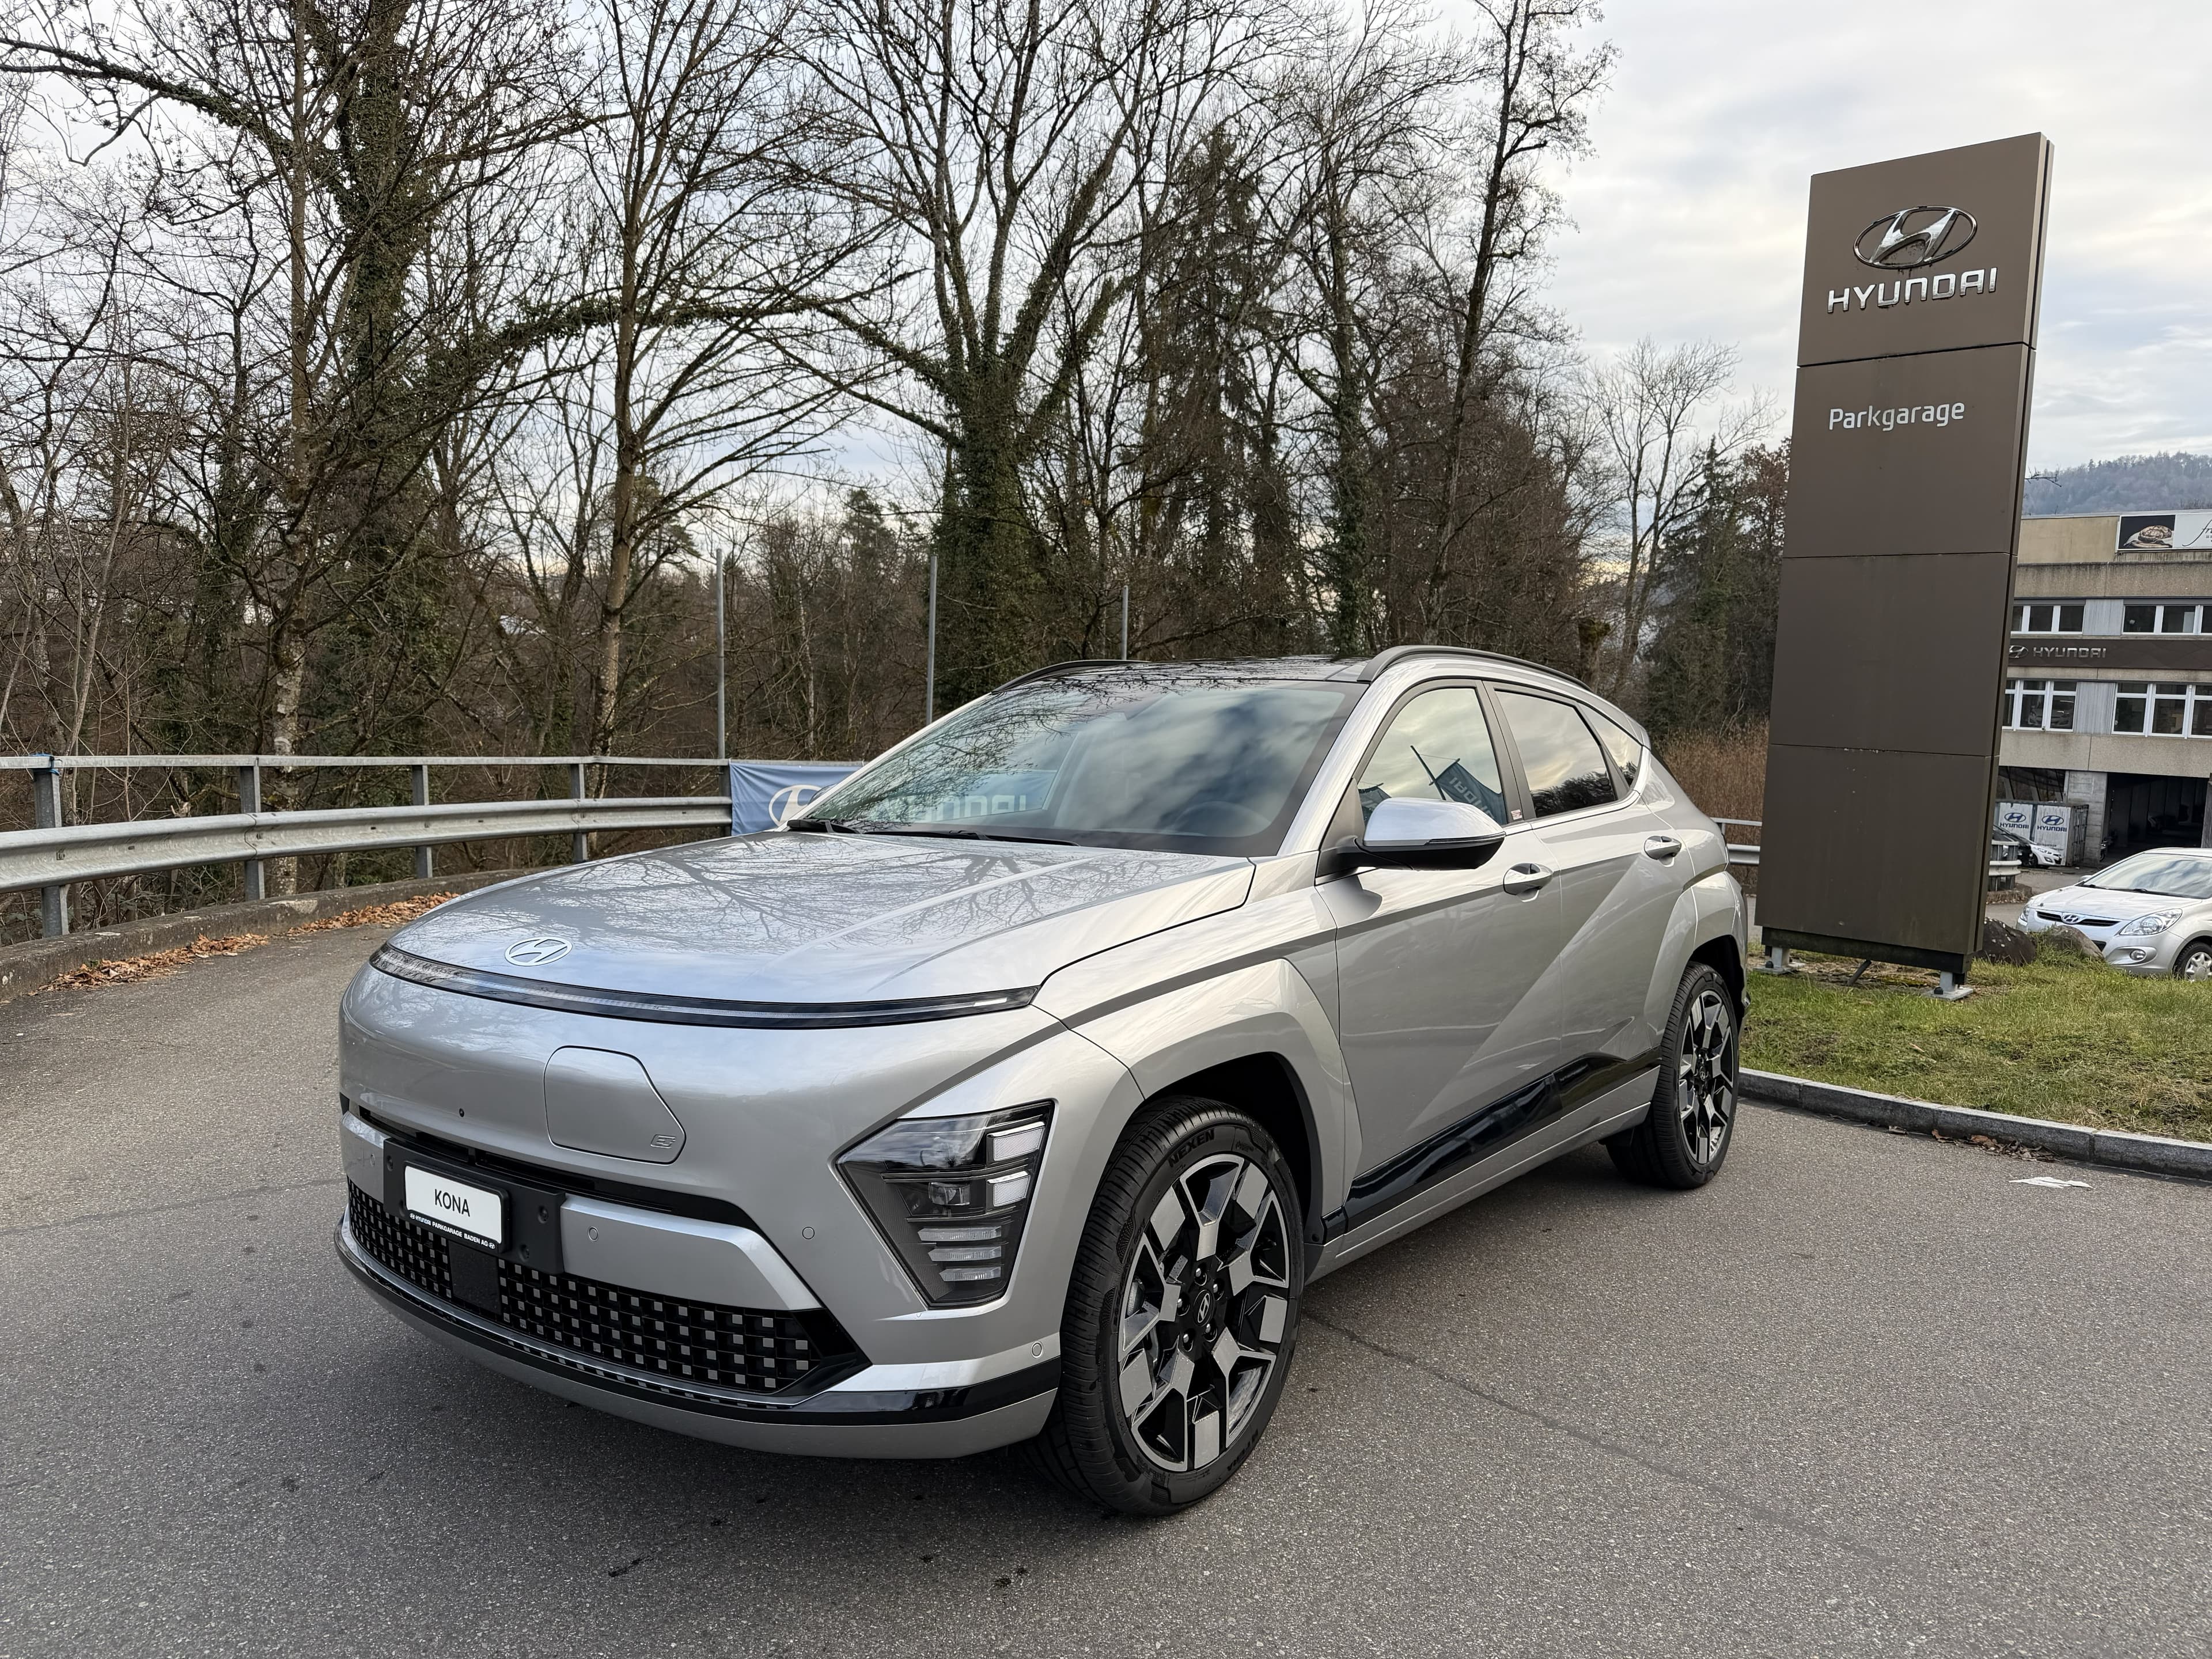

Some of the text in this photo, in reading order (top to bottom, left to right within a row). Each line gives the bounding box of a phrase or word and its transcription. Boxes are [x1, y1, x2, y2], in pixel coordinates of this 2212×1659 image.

[1827, 267, 1998, 313] HYUNDAI
[1828, 402, 1965, 431] Parkgarage
[2033, 646, 2107, 658] HYUNDAI
[1168, 1128, 1215, 1168] NEXEN
[435, 1189, 470, 1217] KONA
[415, 1215, 431, 1225] HYUNDAI
[433, 1221, 462, 1237] PARKGARAGE
[464, 1233, 480, 1244] BADEN
